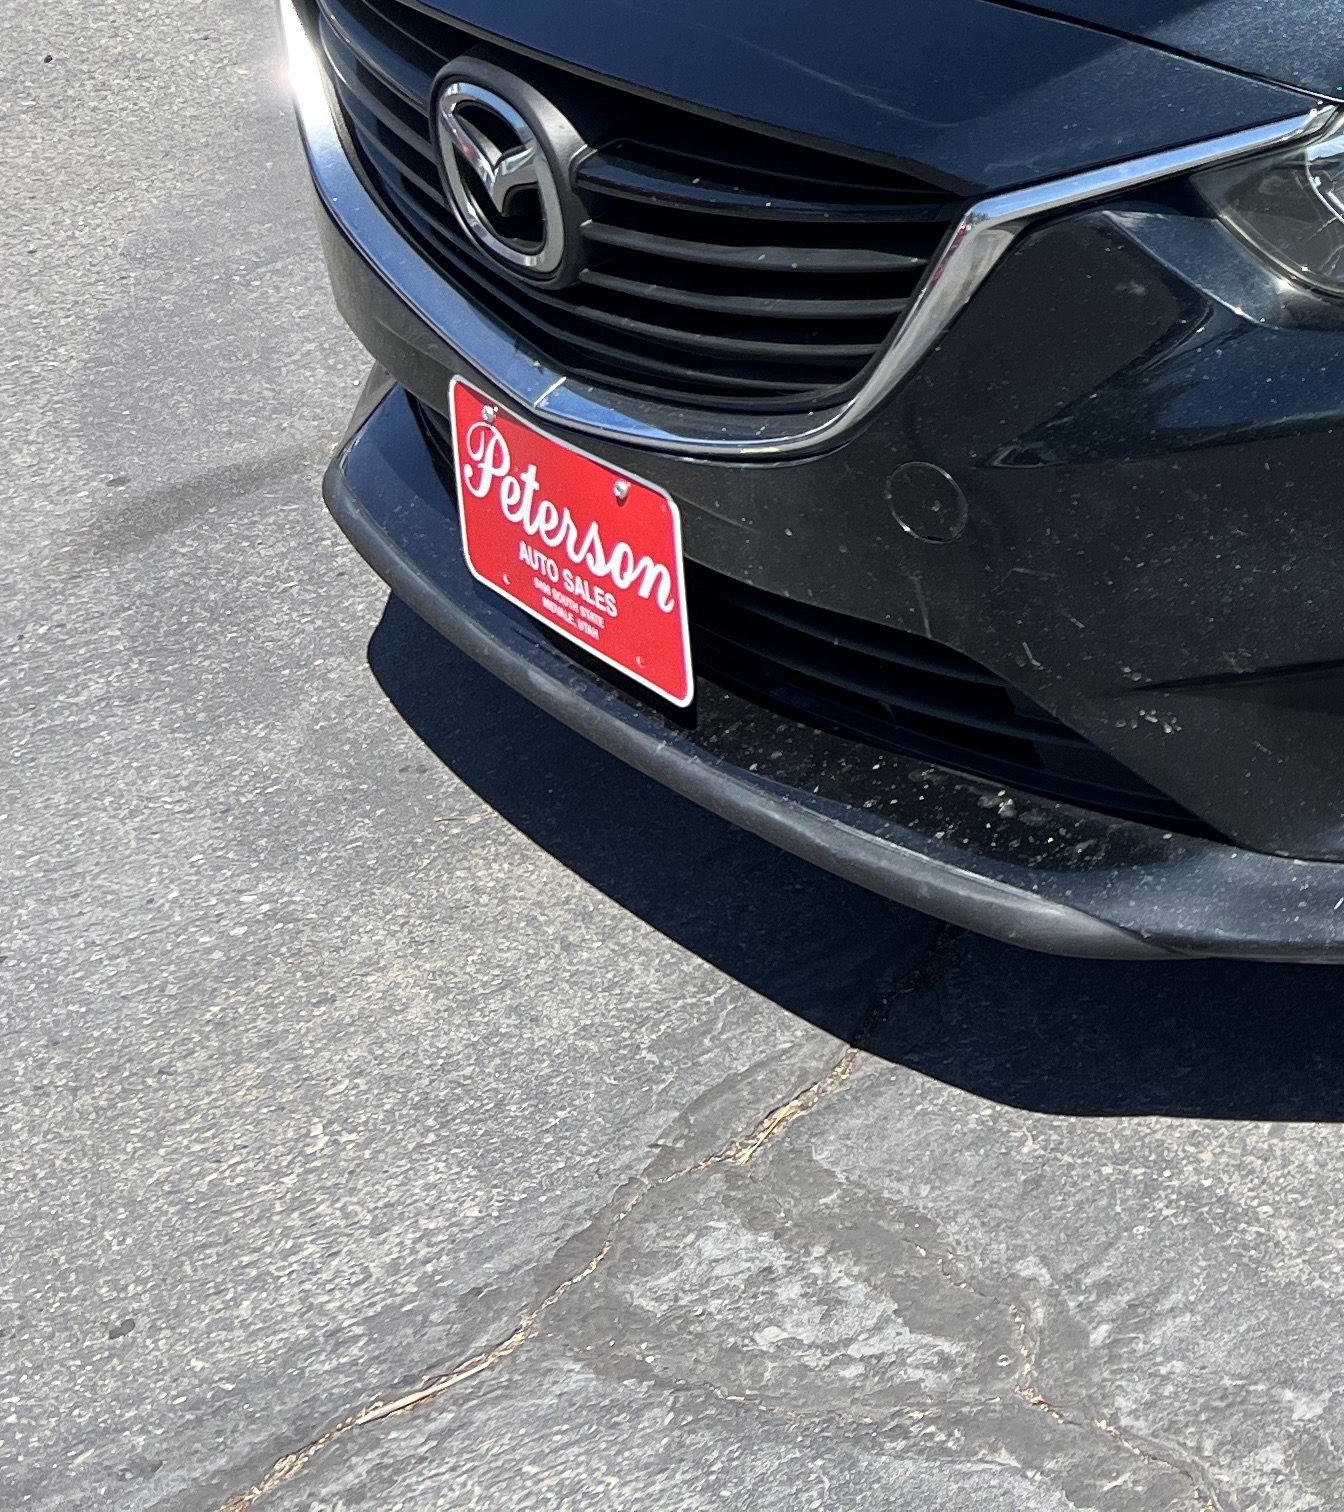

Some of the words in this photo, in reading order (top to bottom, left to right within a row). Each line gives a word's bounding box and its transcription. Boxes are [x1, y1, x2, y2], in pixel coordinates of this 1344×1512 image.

[463, 421, 675, 613] Peterson
[519, 541, 559, 583] AUTO
[562, 568, 618, 618] SALES
